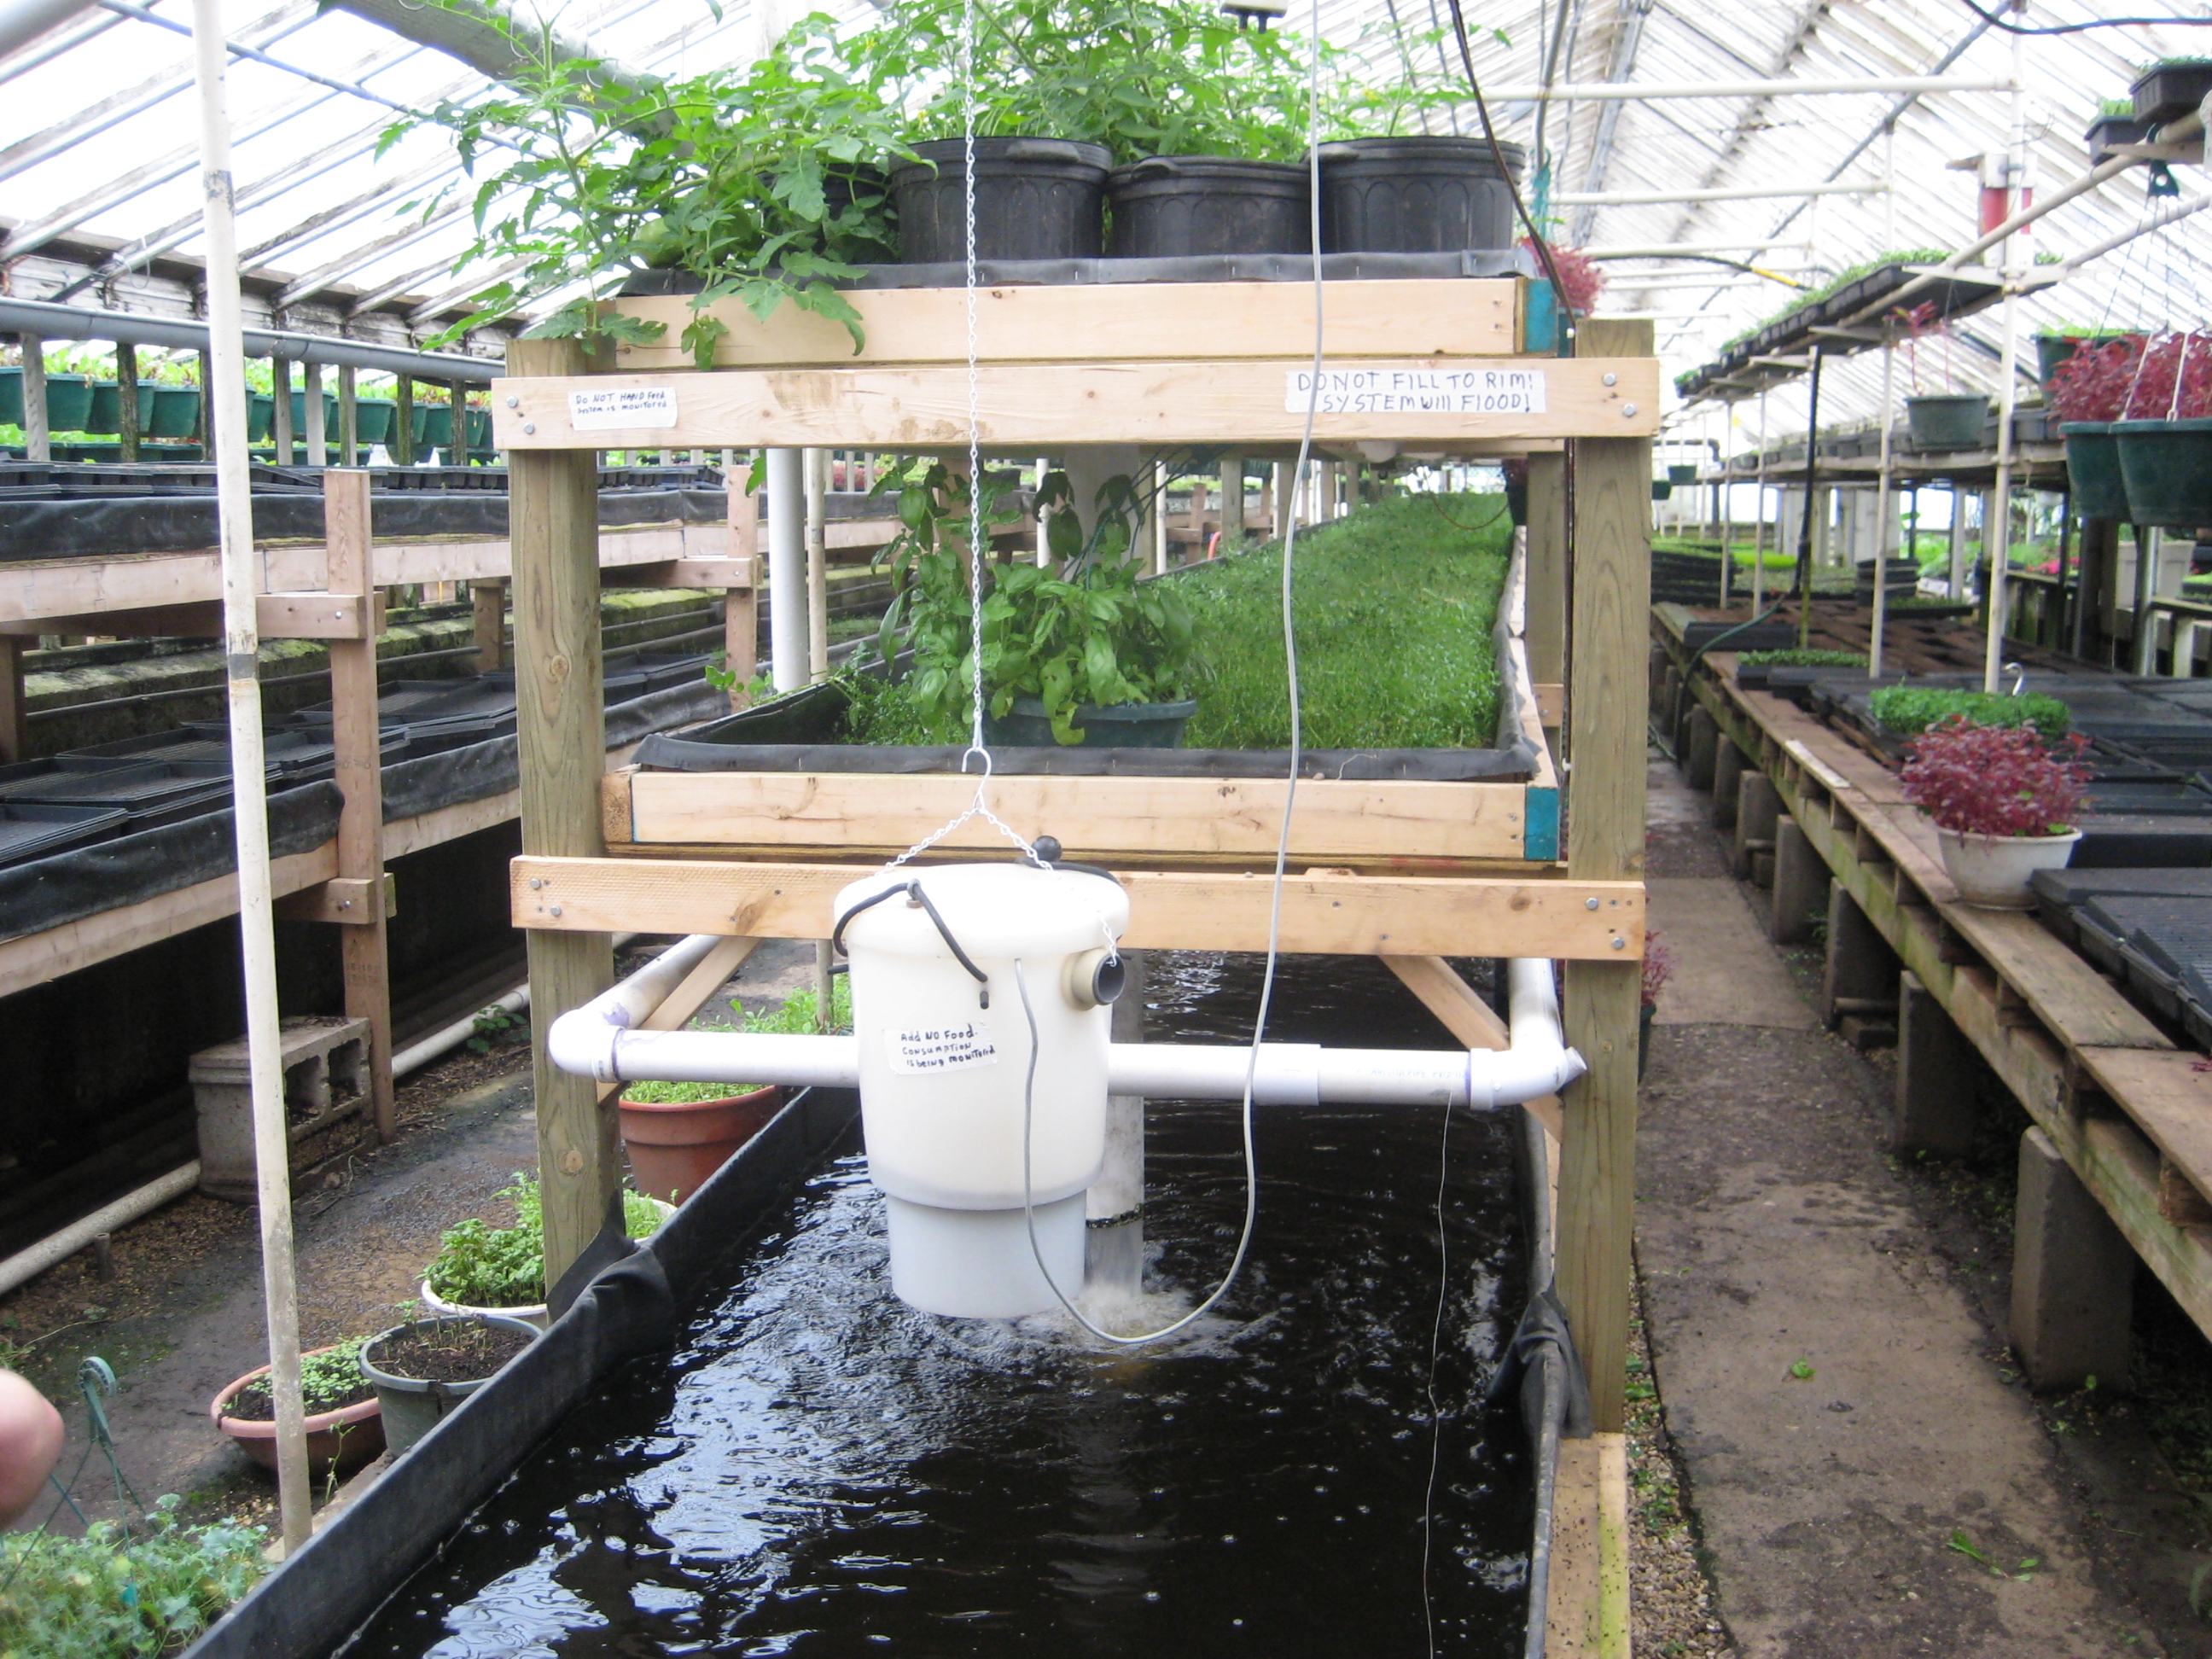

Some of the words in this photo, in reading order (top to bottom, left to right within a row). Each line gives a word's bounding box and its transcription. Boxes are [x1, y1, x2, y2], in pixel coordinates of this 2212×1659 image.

[1298, 372, 1327, 392] DO
[1333, 371, 1380, 391] NOT
[1394, 372, 1440, 391] FILL
[1447, 371, 1475, 388] TO
[1486, 371, 1534, 390] RIM!
[592, 393, 615, 403] NOT
[1323, 393, 1415, 413] SYSTEM
